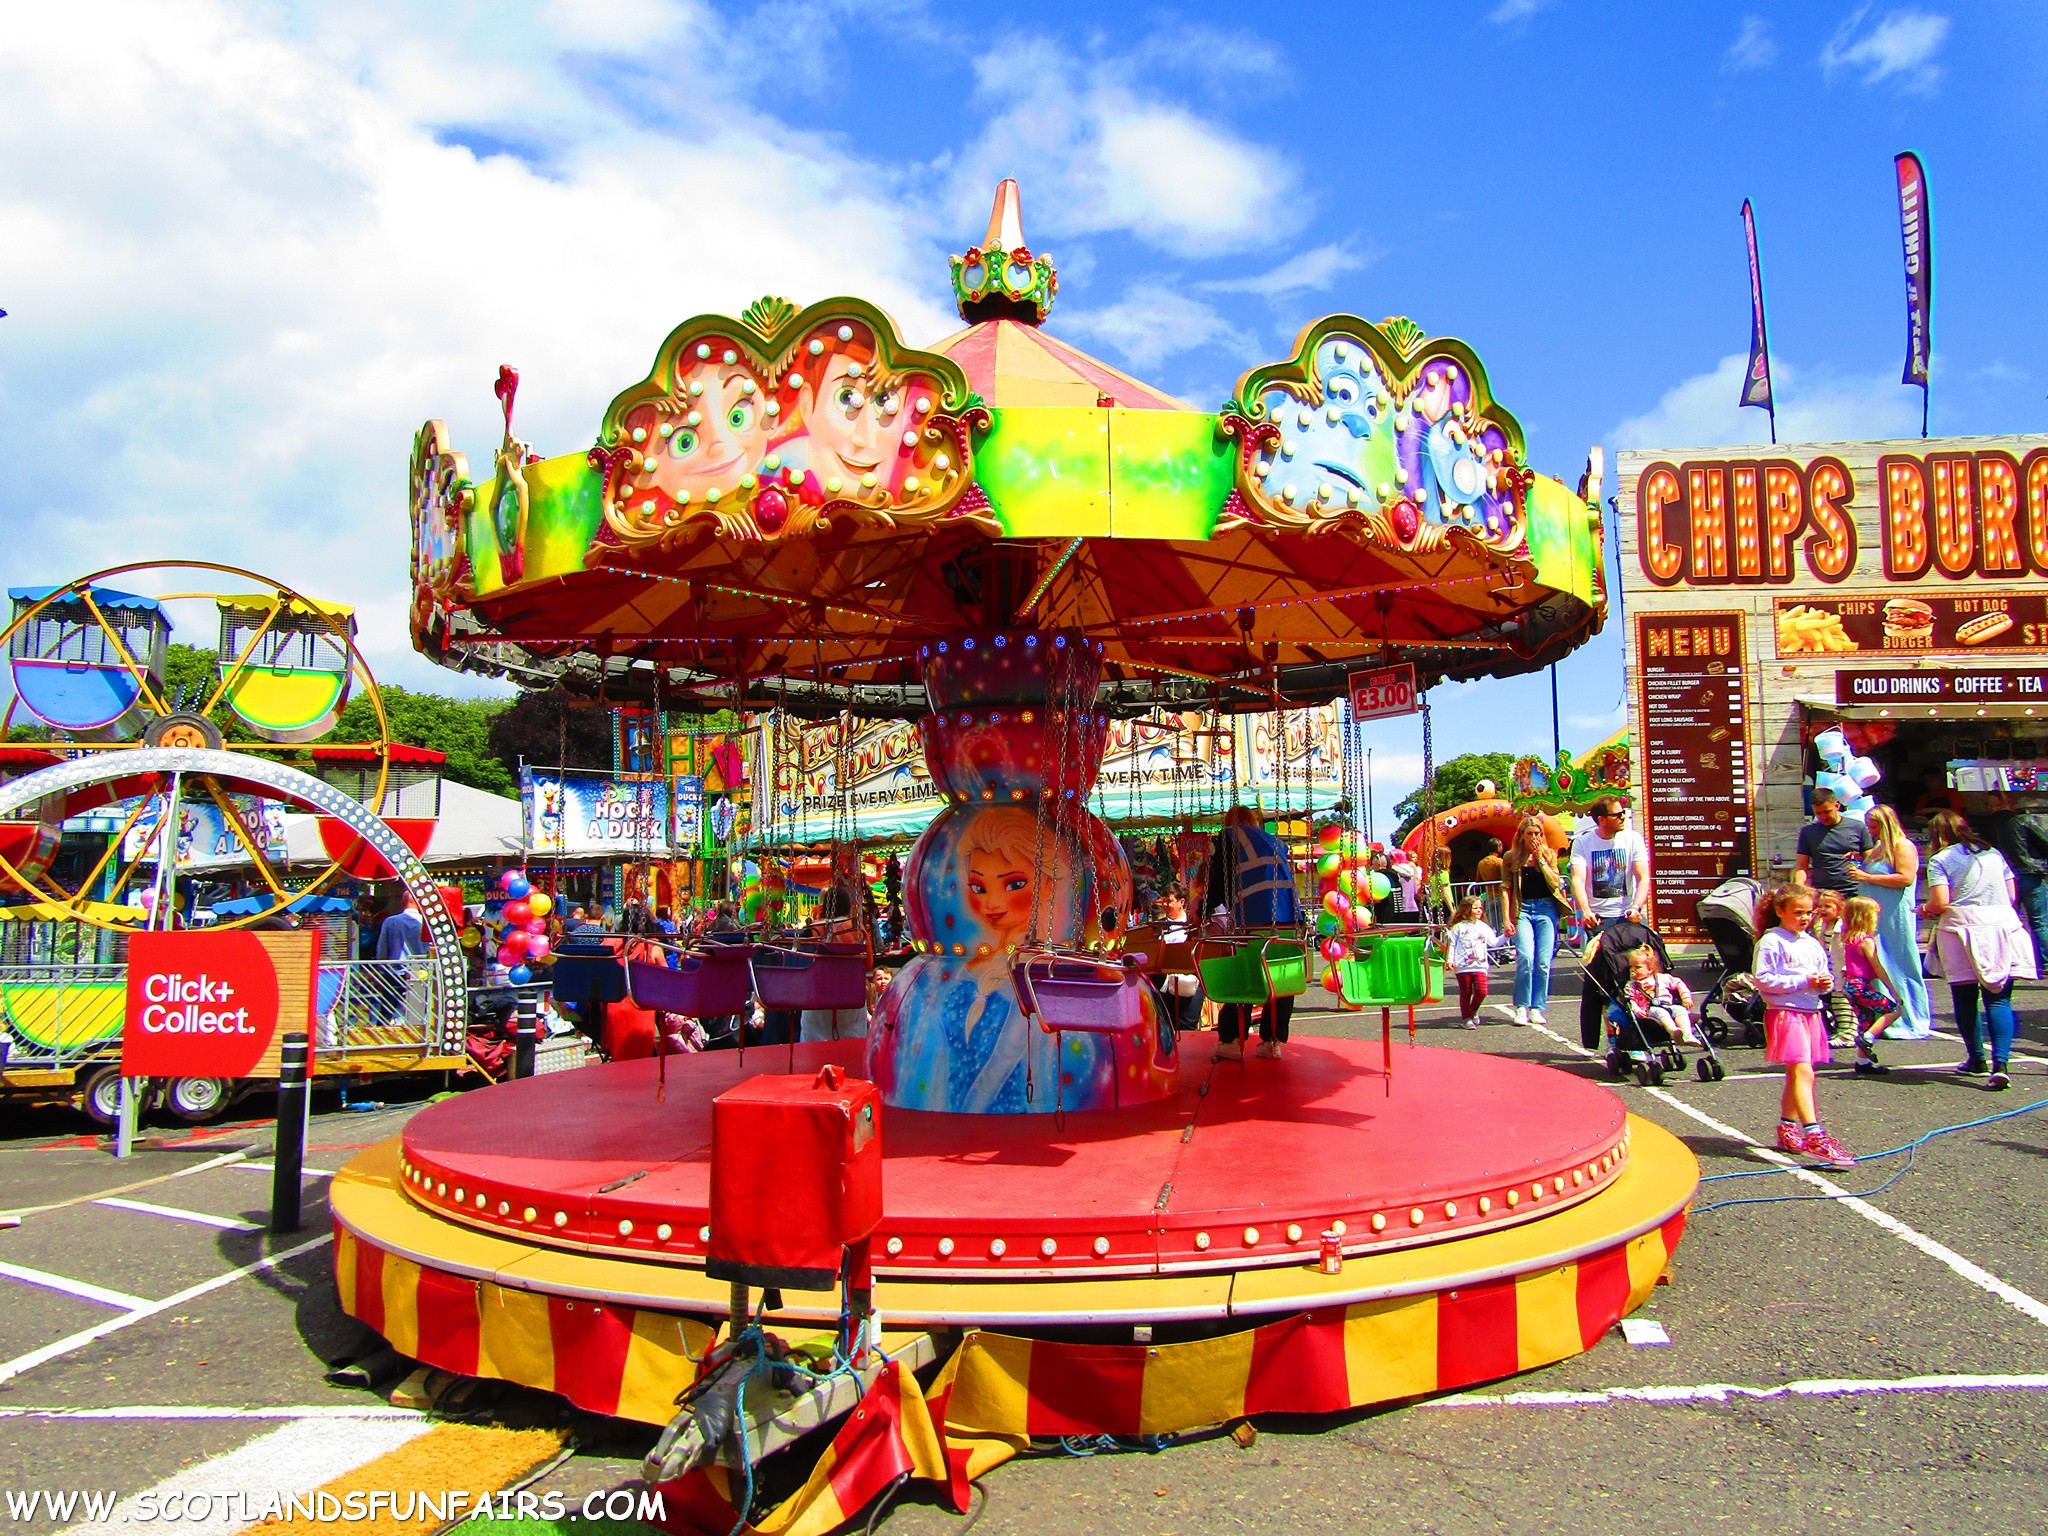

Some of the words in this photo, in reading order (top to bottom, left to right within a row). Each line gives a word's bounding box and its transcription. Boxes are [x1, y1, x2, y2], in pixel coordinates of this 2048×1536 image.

[1645, 464, 1849, 580] CHIPS
[1838, 602, 1875, 615] CHIPS
[1954, 600, 1979, 613] HOT
[1982, 599, 2008, 612] DOG
[1648, 627, 1730, 656] MENU
[1883, 635, 1933, 649] BURGER
[1369, 674, 1396, 686] FARE
[1853, 678, 1888, 695] COLD
[1890, 677, 1940, 694] DRINKS
[1954, 676, 2003, 693] COFFEE
[2016, 676, 2043, 693] TEA
[1357, 682, 1408, 711] £3.00
[806, 716, 884, 768] HOO
[846, 724, 923, 783] DUCK
[1096, 769, 1152, 785] EVERY
[1160, 764, 1204, 781] TIME
[804, 795, 846, 809] PRIZE
[851, 789, 897, 807] EVERY
[902, 782, 940, 800] TIME
[586, 820, 603, 839] A
[608, 819, 662, 839] DUCK
[214, 833, 228, 855] A
[232, 830, 271, 852] DC
[485, 890, 512, 900] DUCK
[145, 973, 235, 1002] Click+
[143, 1004, 256, 1033] Collect.
